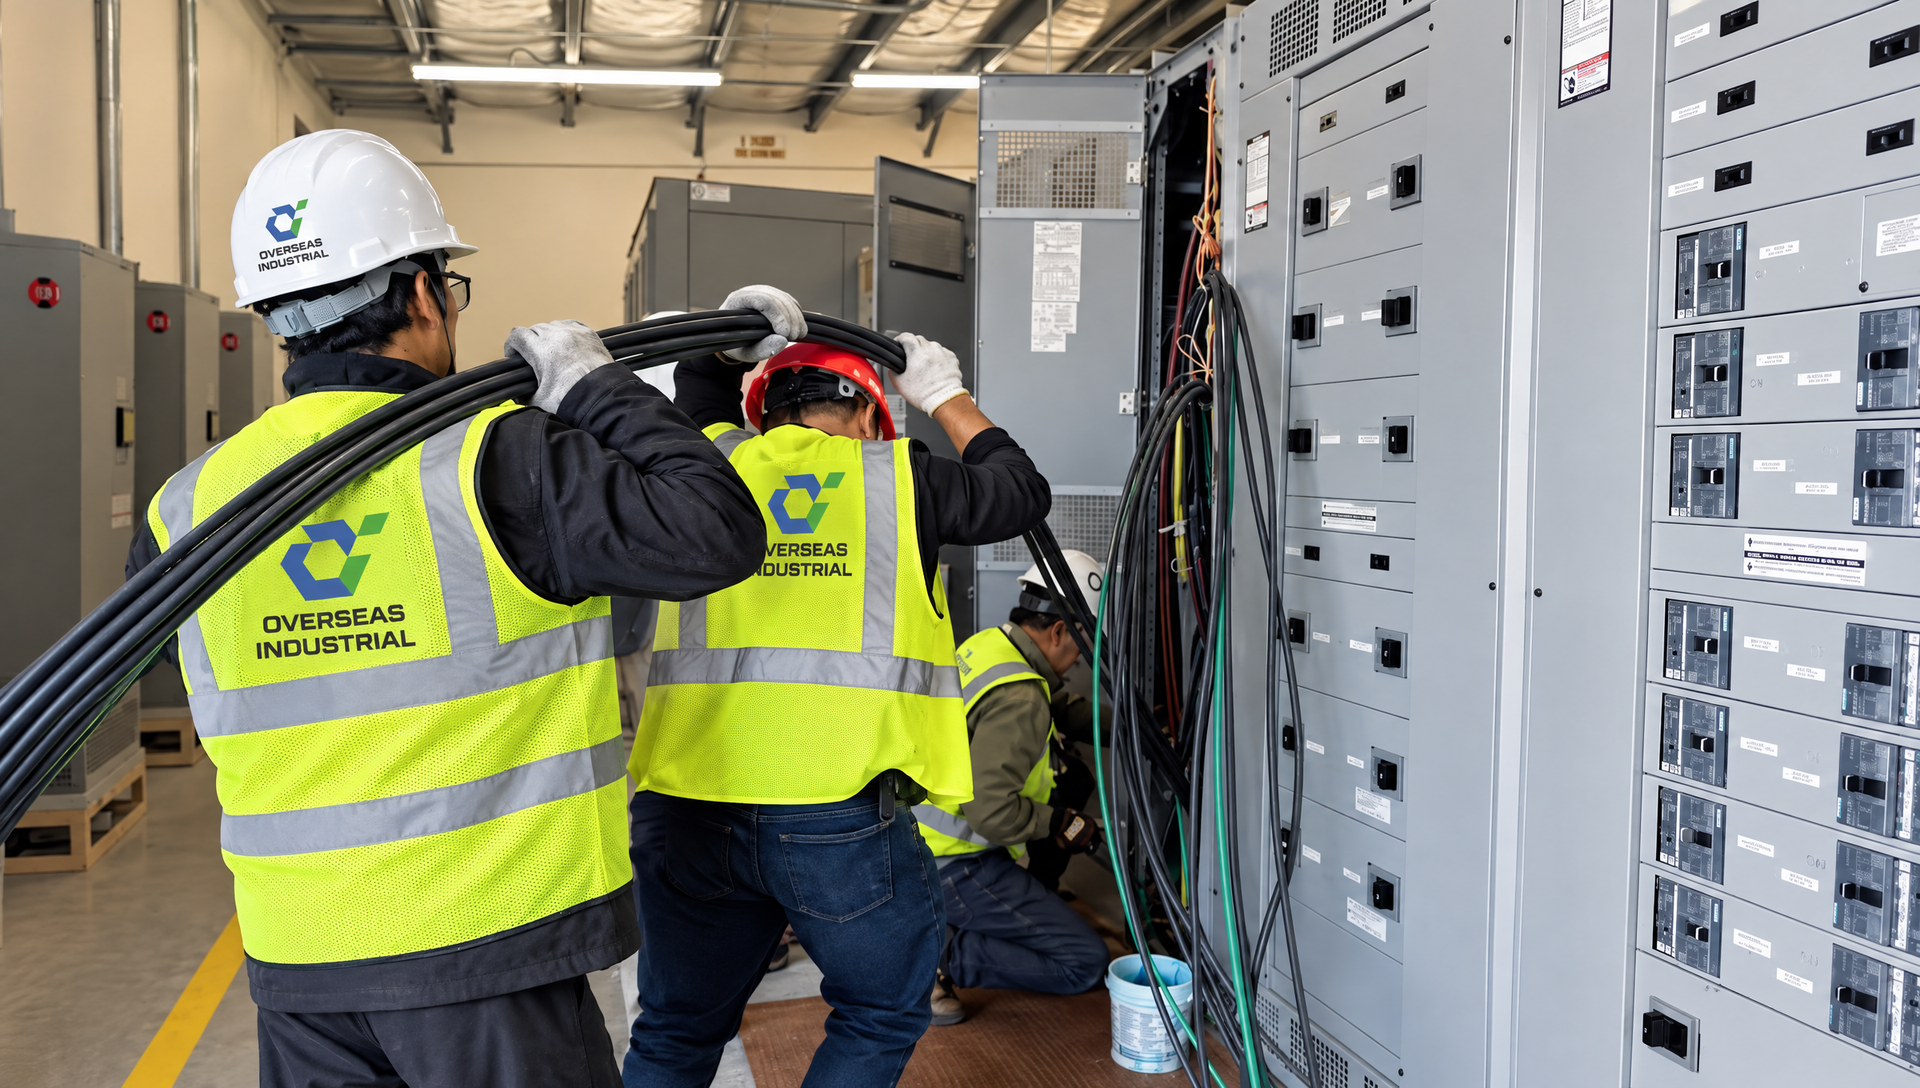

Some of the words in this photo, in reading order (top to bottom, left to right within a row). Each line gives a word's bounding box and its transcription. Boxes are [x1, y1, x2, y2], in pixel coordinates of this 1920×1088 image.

[258, 238, 323, 260] OVERSEAS
[257, 249, 330, 272] INDUSTRIAL
[765, 542, 848, 557] VERSEAS
[752, 562, 853, 577] DUSTRIAL
[262, 604, 405, 634] OVERSEAS
[256, 630, 416, 660] INDUSTRIAL
